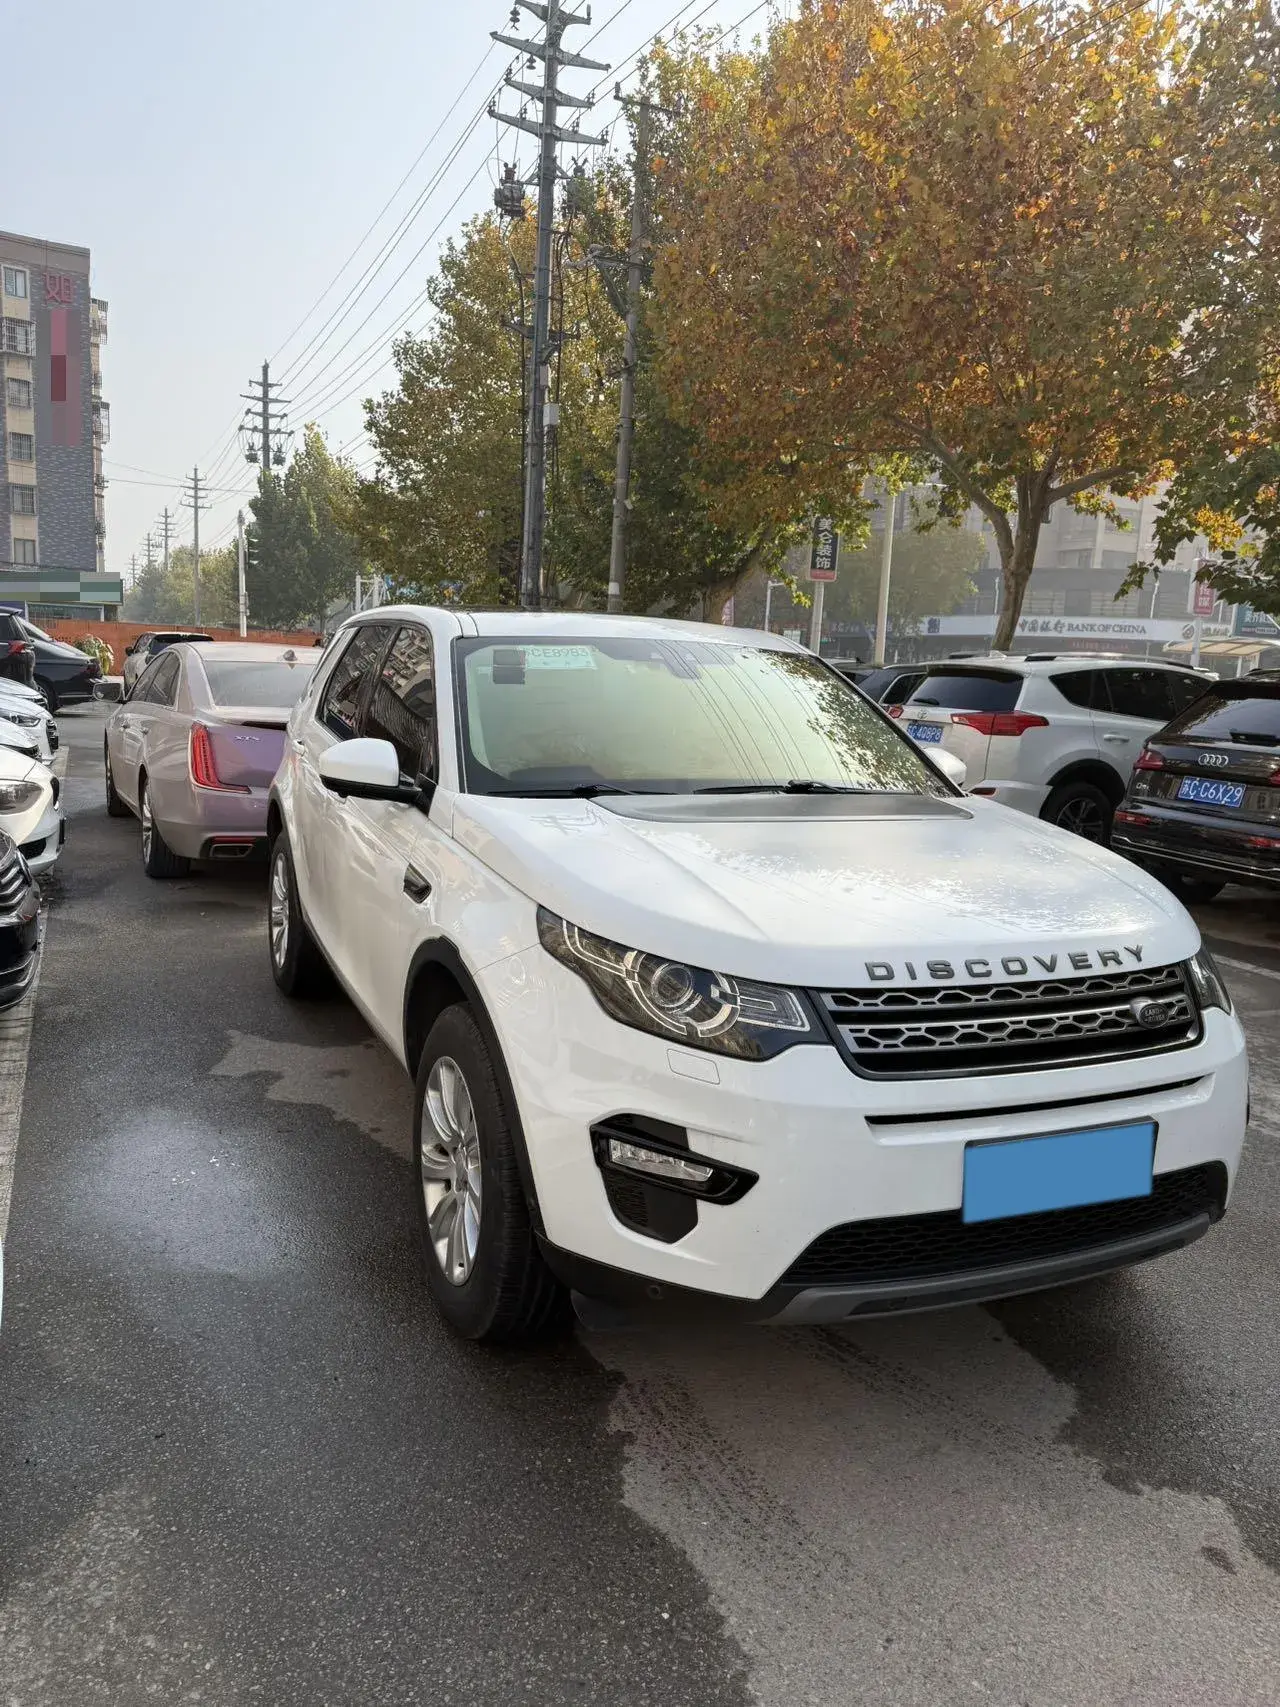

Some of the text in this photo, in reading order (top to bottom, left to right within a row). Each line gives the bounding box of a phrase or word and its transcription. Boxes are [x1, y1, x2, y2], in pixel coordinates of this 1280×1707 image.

[41, 272, 73, 304] 如
[1019, 619, 1066, 634] 中国银行
[1067, 623, 1147, 635] BANK OF CHINA
[864, 944, 1144, 981] DISCOVERY
